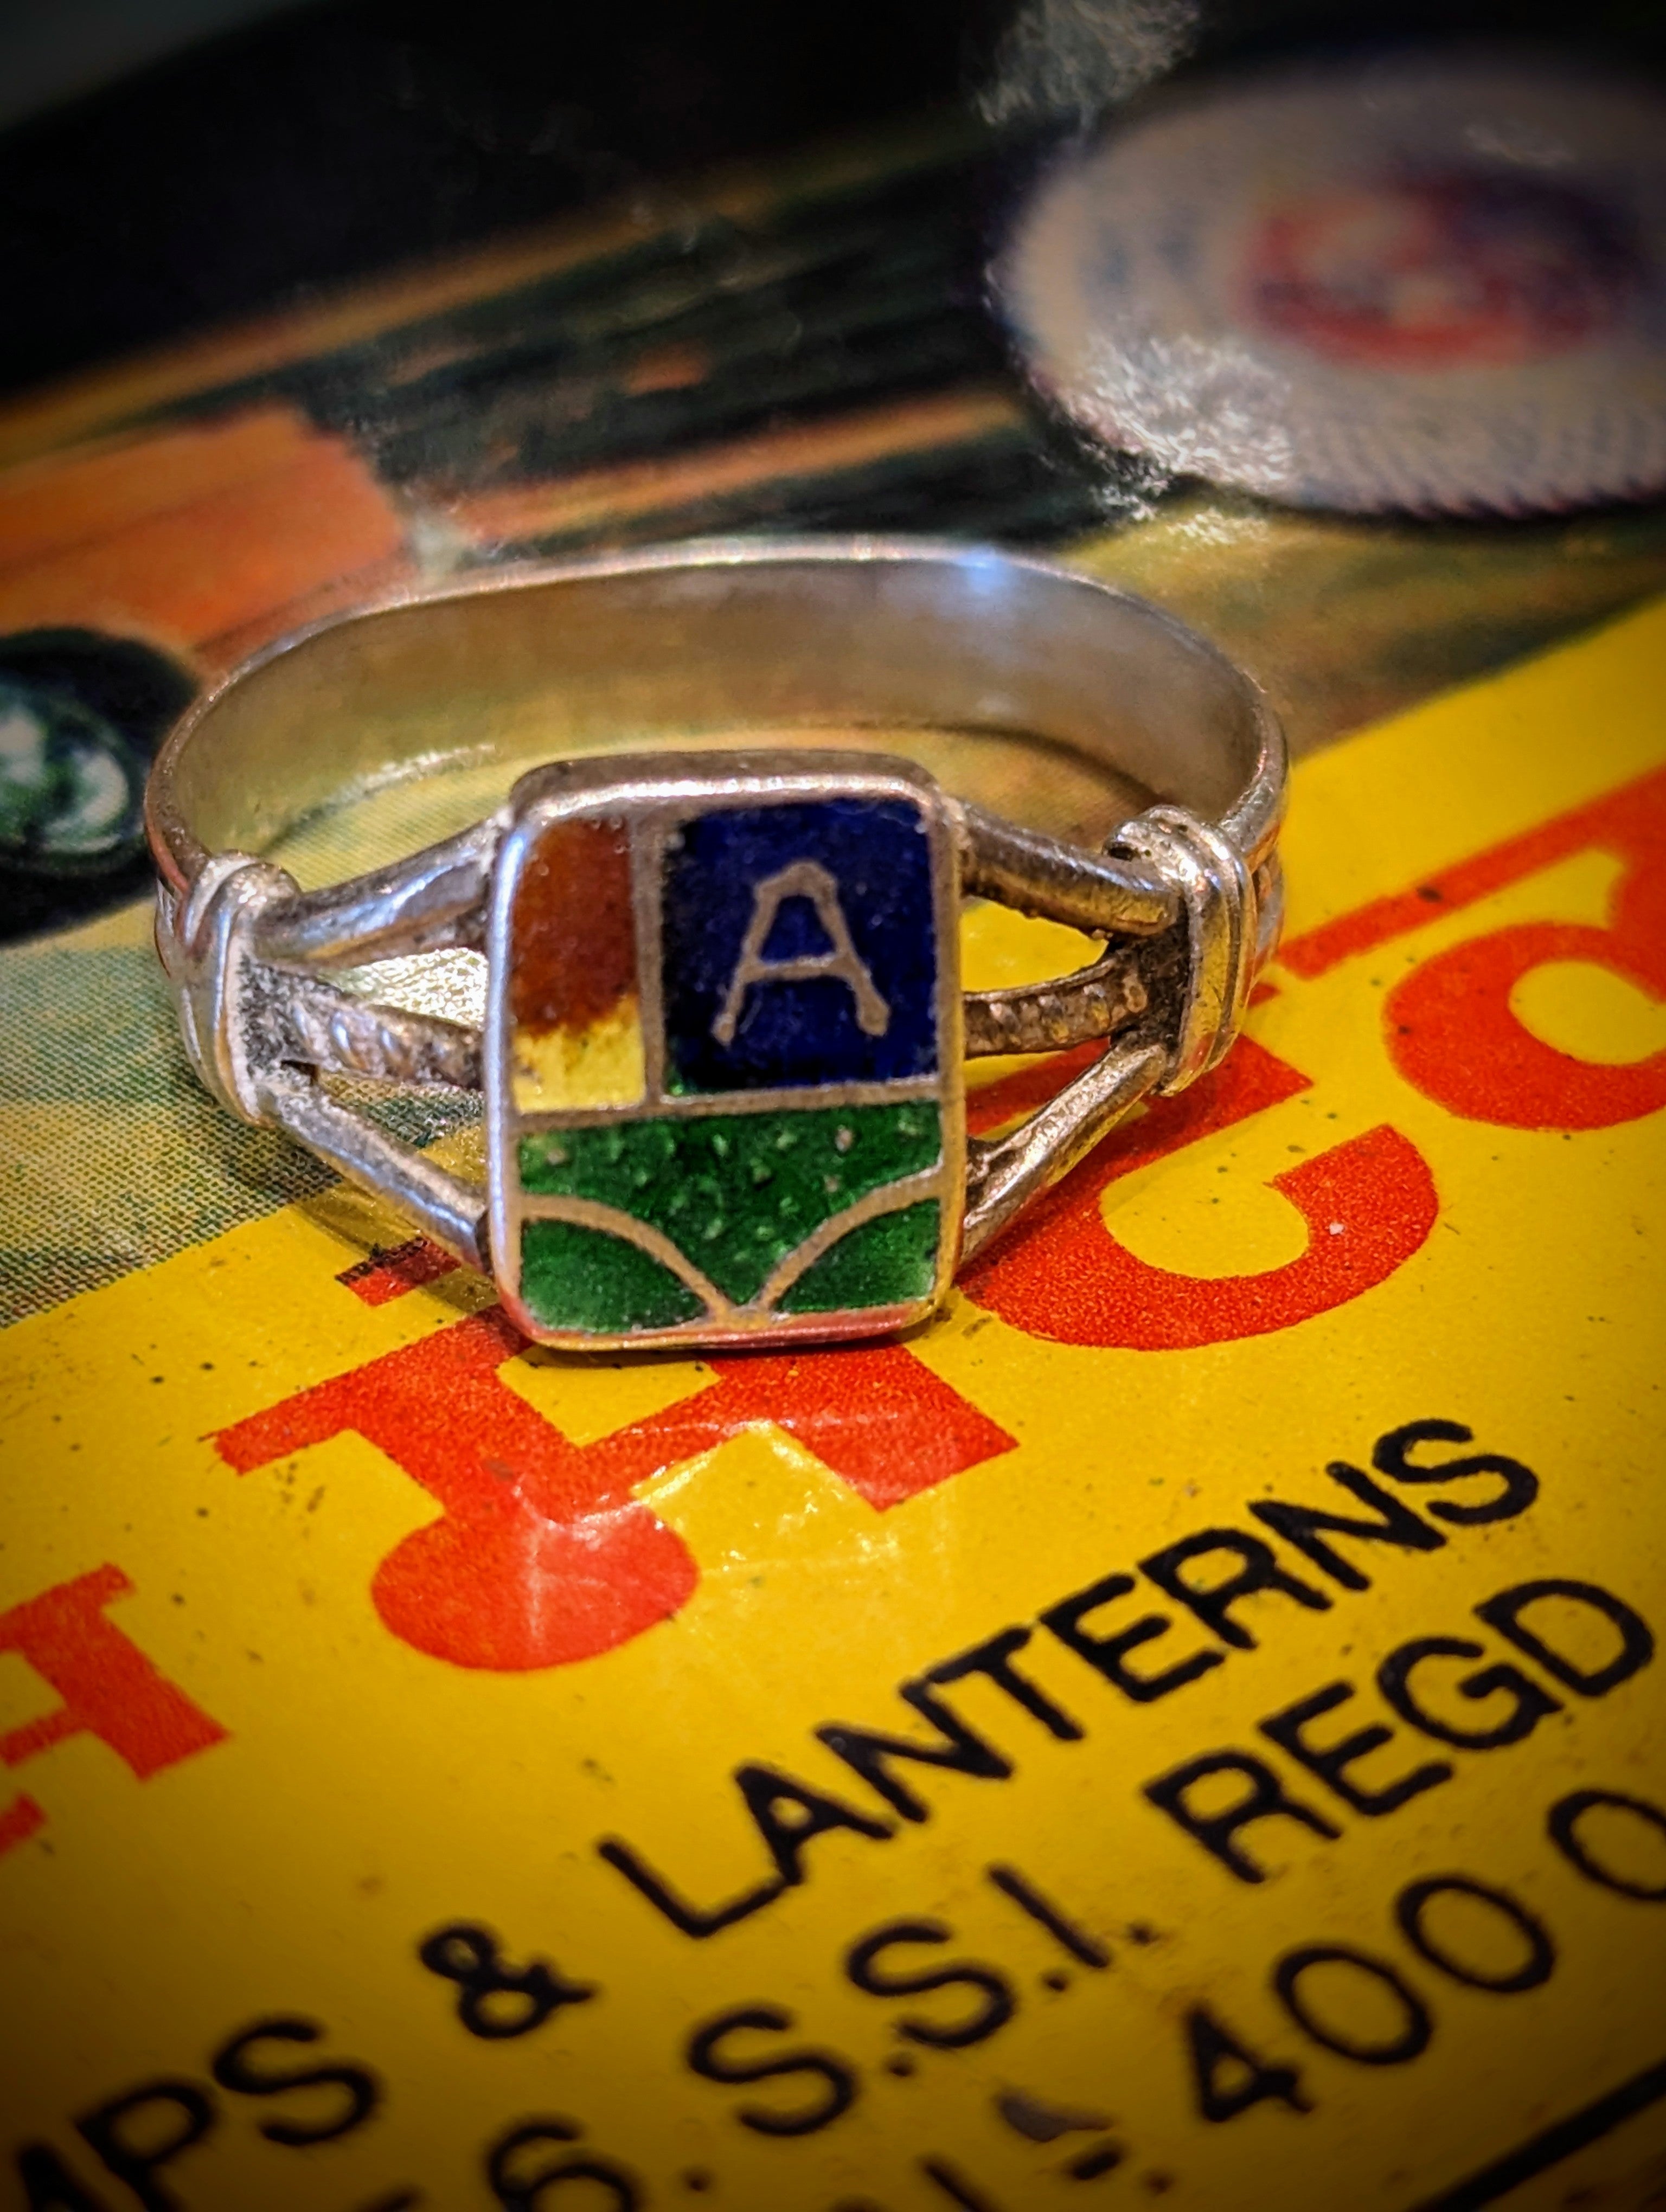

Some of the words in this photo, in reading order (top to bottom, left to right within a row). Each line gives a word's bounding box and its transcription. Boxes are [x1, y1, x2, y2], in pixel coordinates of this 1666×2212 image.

[712, 858, 890, 1050] A
[418, 1922, 597, 2042] &
[598, 1418, 1540, 1940] LANTERNS
[1142, 1579, 1656, 1885] REGD
